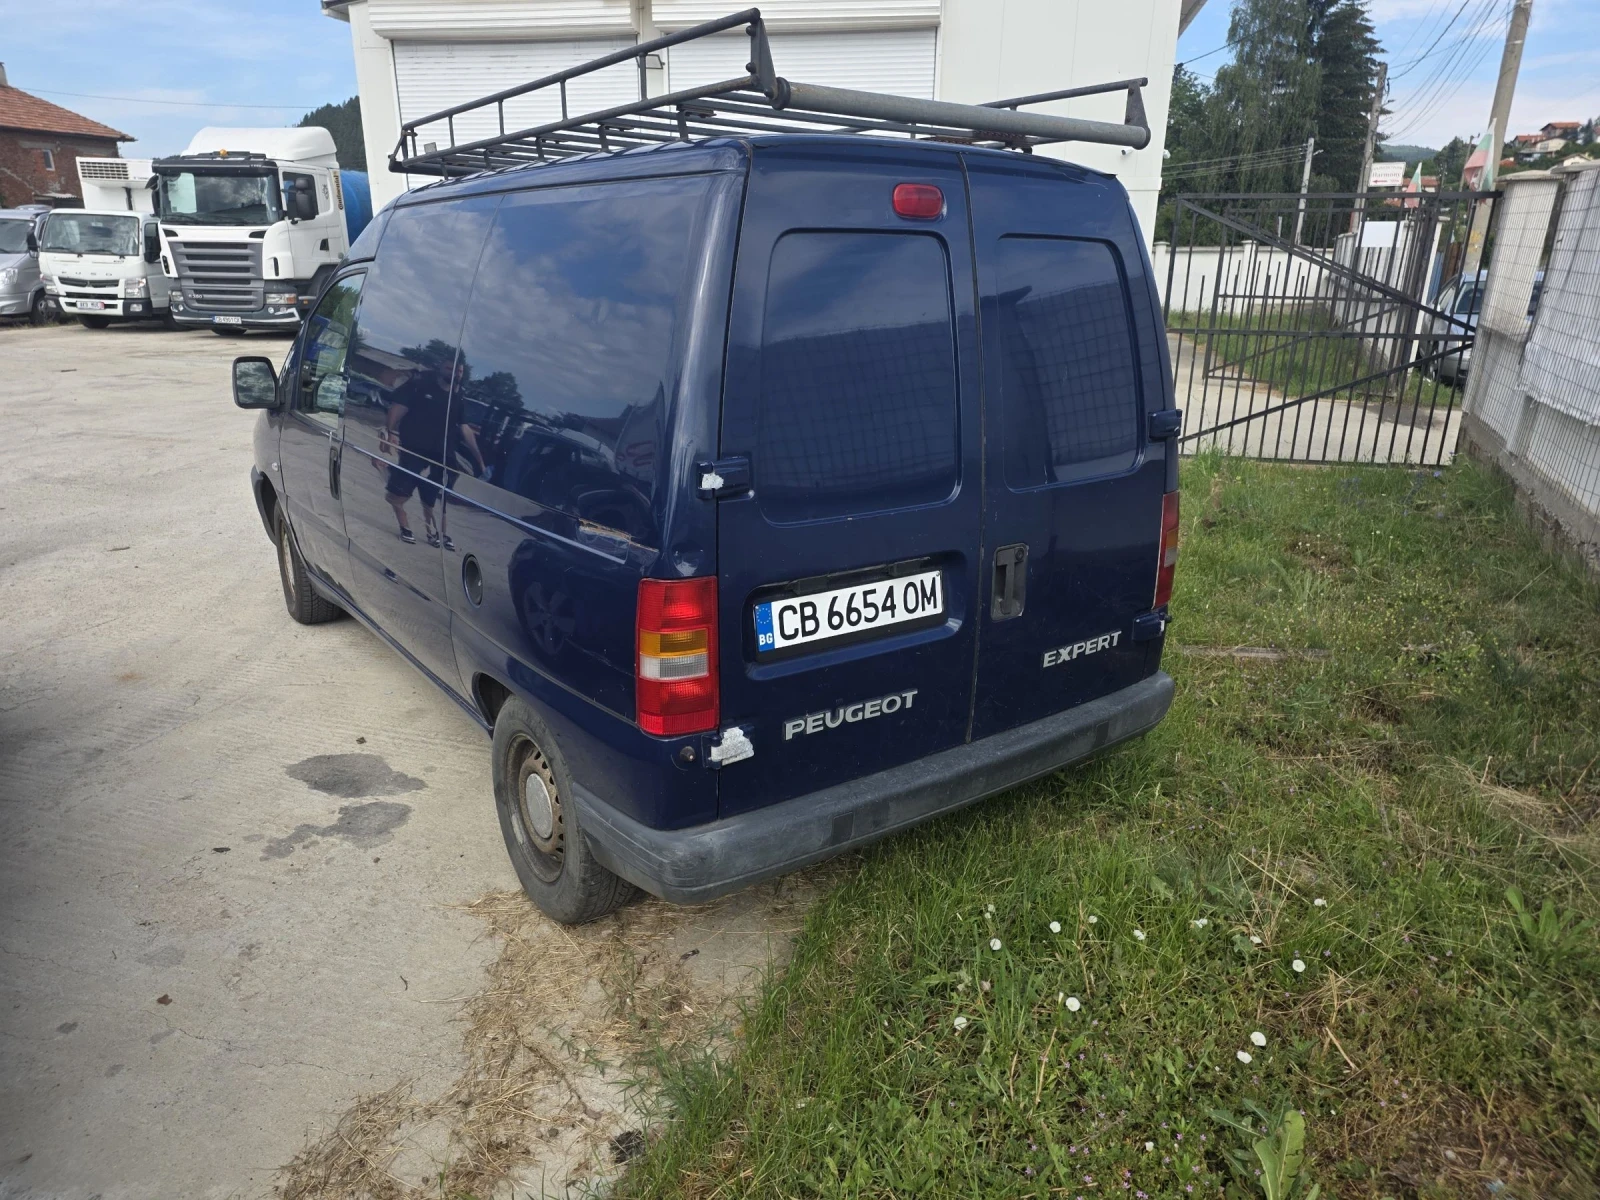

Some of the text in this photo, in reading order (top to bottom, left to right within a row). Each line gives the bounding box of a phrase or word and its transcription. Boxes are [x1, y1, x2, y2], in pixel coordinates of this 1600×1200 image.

[333, 175, 343, 210] Continental
[778, 576, 938, 641] CB 6654 OM
[758, 633, 773, 646] BG
[1042, 630, 1122, 668] EXPERT
[784, 689, 918, 740] PEUGEOT
